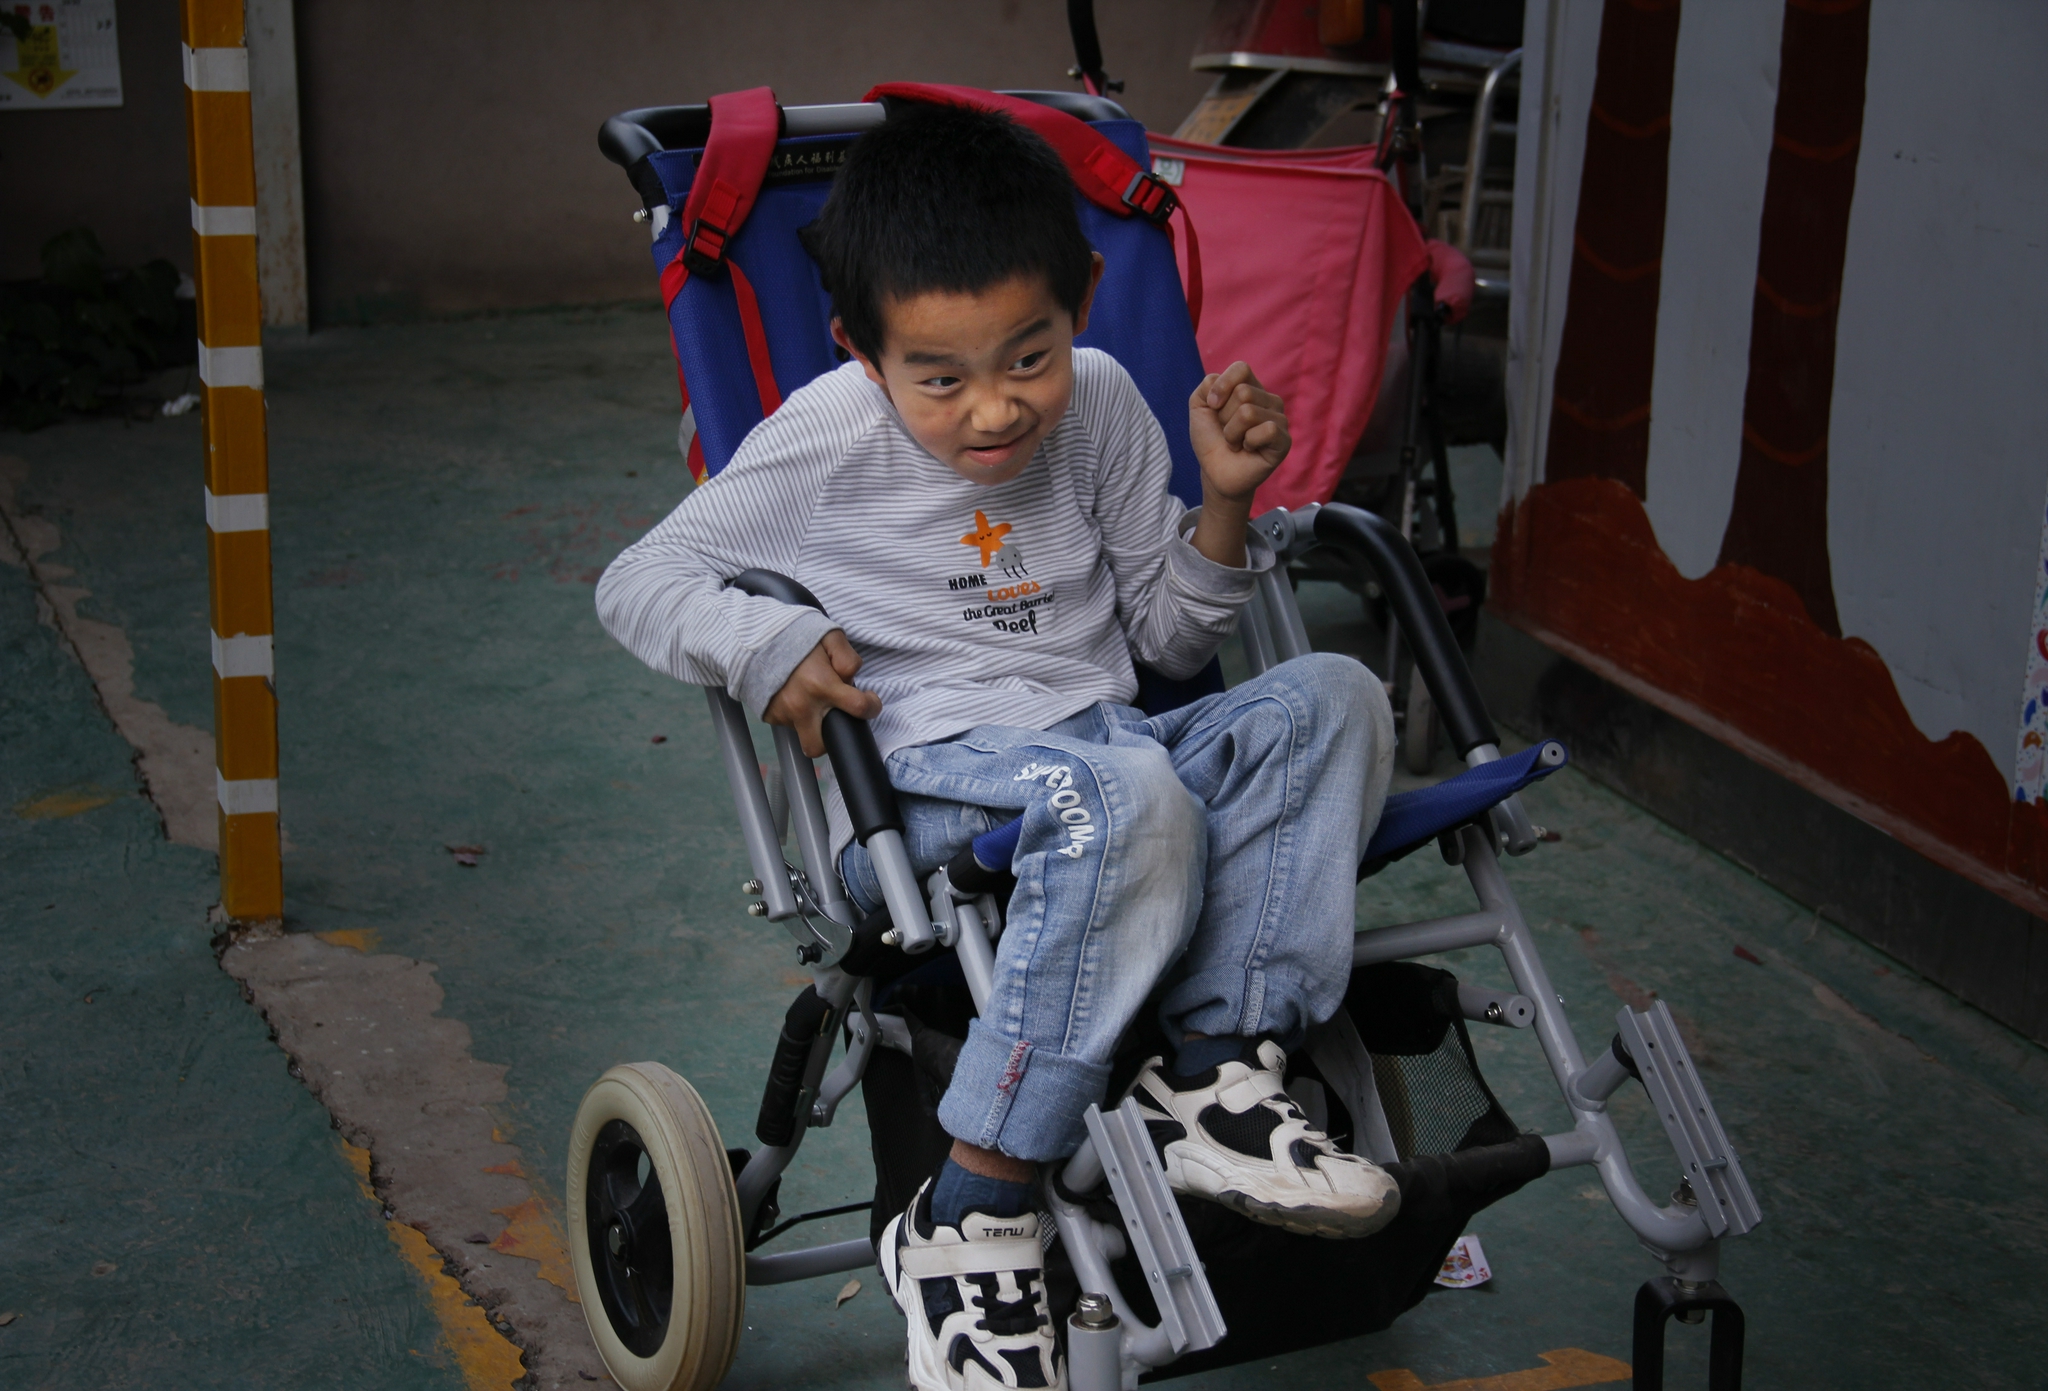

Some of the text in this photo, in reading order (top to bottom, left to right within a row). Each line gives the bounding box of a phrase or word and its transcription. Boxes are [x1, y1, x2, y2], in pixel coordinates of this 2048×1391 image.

[768, 167, 804, 178] oundation
[948, 574, 987, 590] HOME
[963, 608, 982, 621] the
[984, 605, 1018, 618] Great
